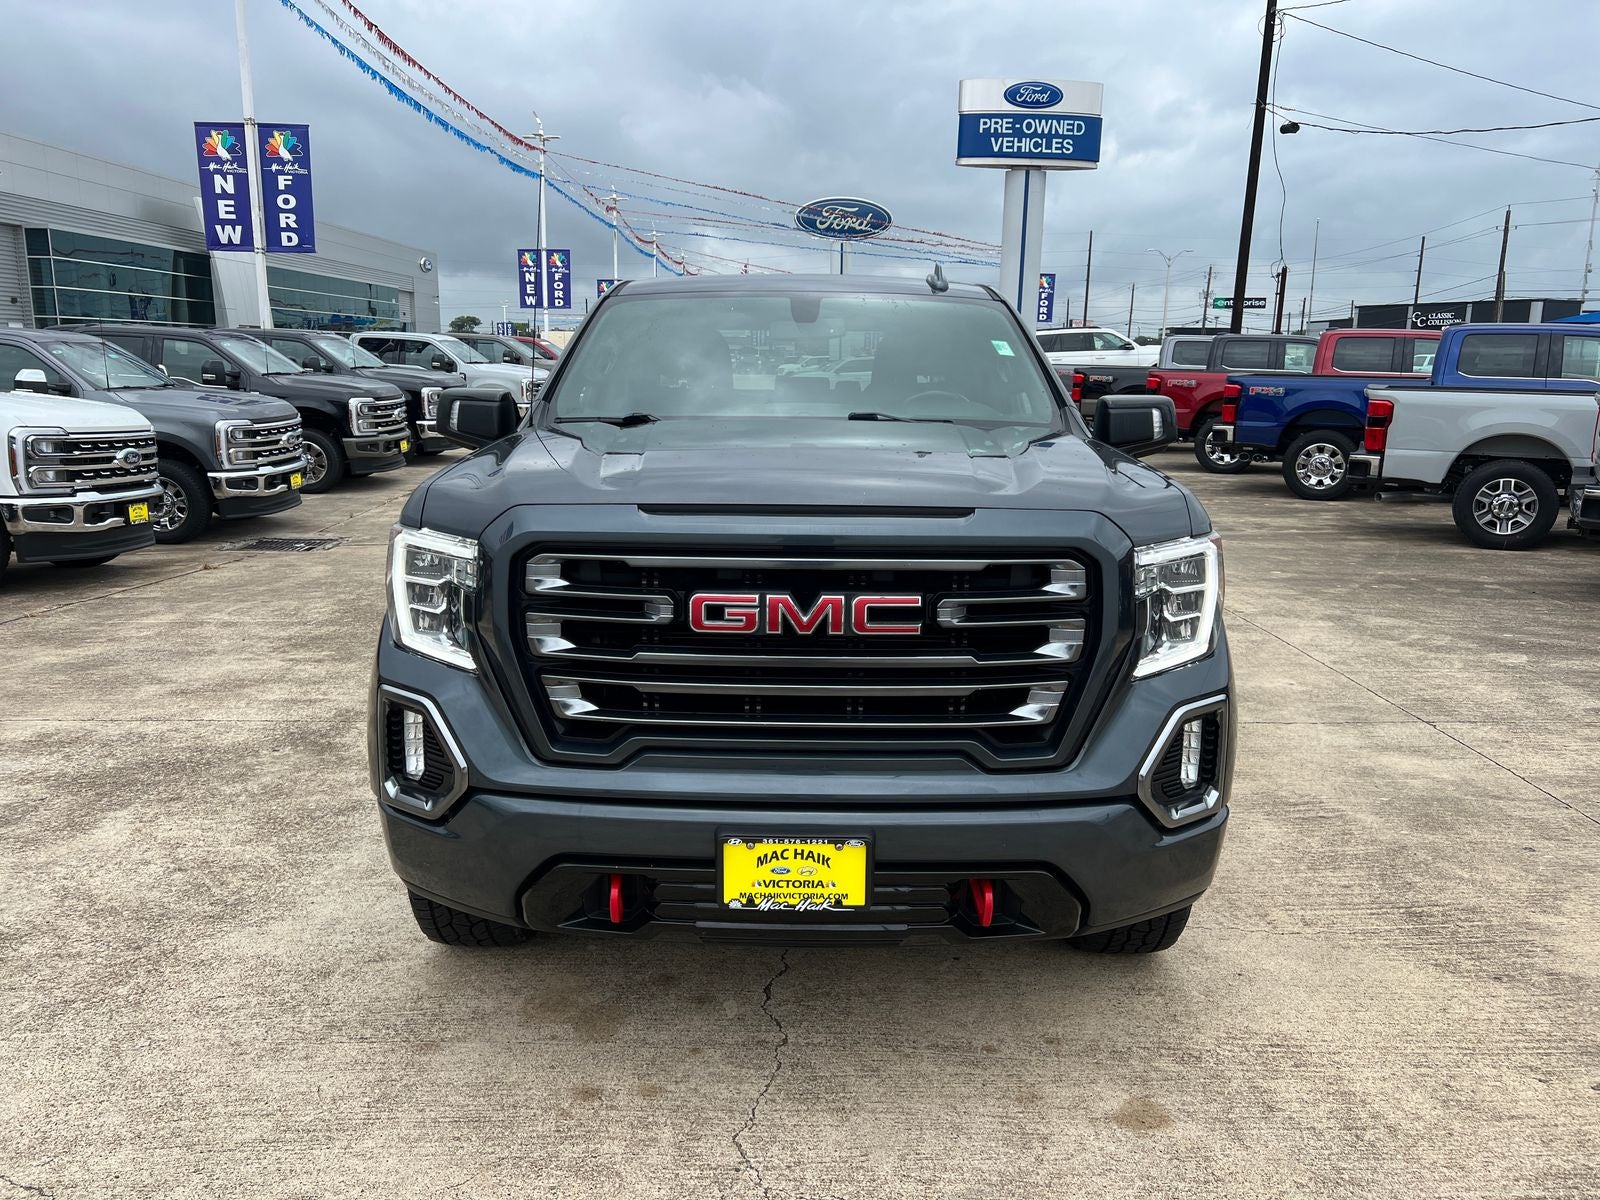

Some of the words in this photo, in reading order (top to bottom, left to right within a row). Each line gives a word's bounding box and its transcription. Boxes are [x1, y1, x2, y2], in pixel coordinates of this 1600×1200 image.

[1016, 85, 1050, 103] Ford
[990, 137, 1073, 154] VEHICLES
[213, 174, 242, 245] NEW
[276, 175, 299, 247] FORD
[816, 205, 873, 231] Ford
[525, 272, 537, 305] NEW
[553, 273, 564, 307] FORD
[1039, 293, 1048, 320] FORD
[1249, 386, 1286, 396] FX4
[690, 593, 922, 635] GMC
[756, 848, 790, 868] MAC
[793, 848, 832, 869] HAIK
[763, 879, 825, 889] VICTORIA
[739, 892, 849, 900] MACHAIKVICTORIA.COM
[757, 898, 794, 911] Mac
[795, 898, 834, 912] Haik
